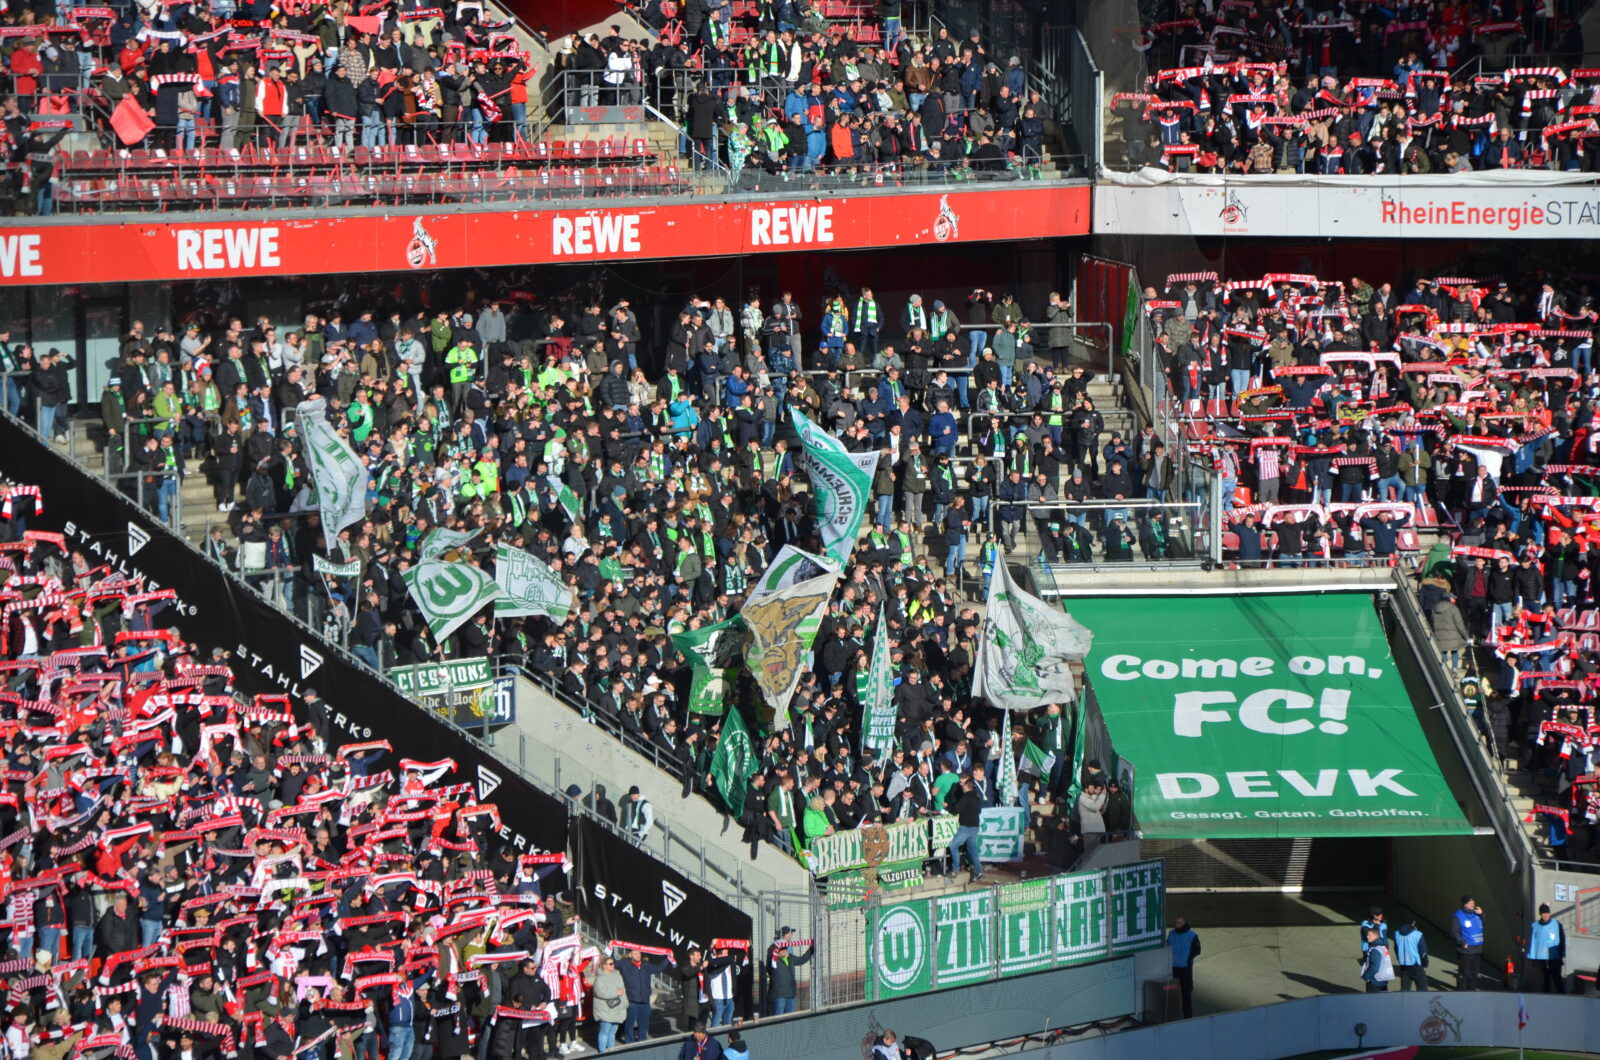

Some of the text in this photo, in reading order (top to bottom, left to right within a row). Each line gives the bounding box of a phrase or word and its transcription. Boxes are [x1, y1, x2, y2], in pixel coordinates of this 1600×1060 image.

[752, 206, 834, 246] REWE
[1382, 200, 1600, 231] RheinEnergieSTA
[177, 227, 281, 270] REWE
[552, 213, 641, 256] REWE
[1101, 654, 1383, 681] Come on,
[1173, 688, 1351, 738] FC!
[1156, 769, 1419, 800] DEVK
[1170, 808, 1430, 820] Gesagt. Getan. Geholfen.
